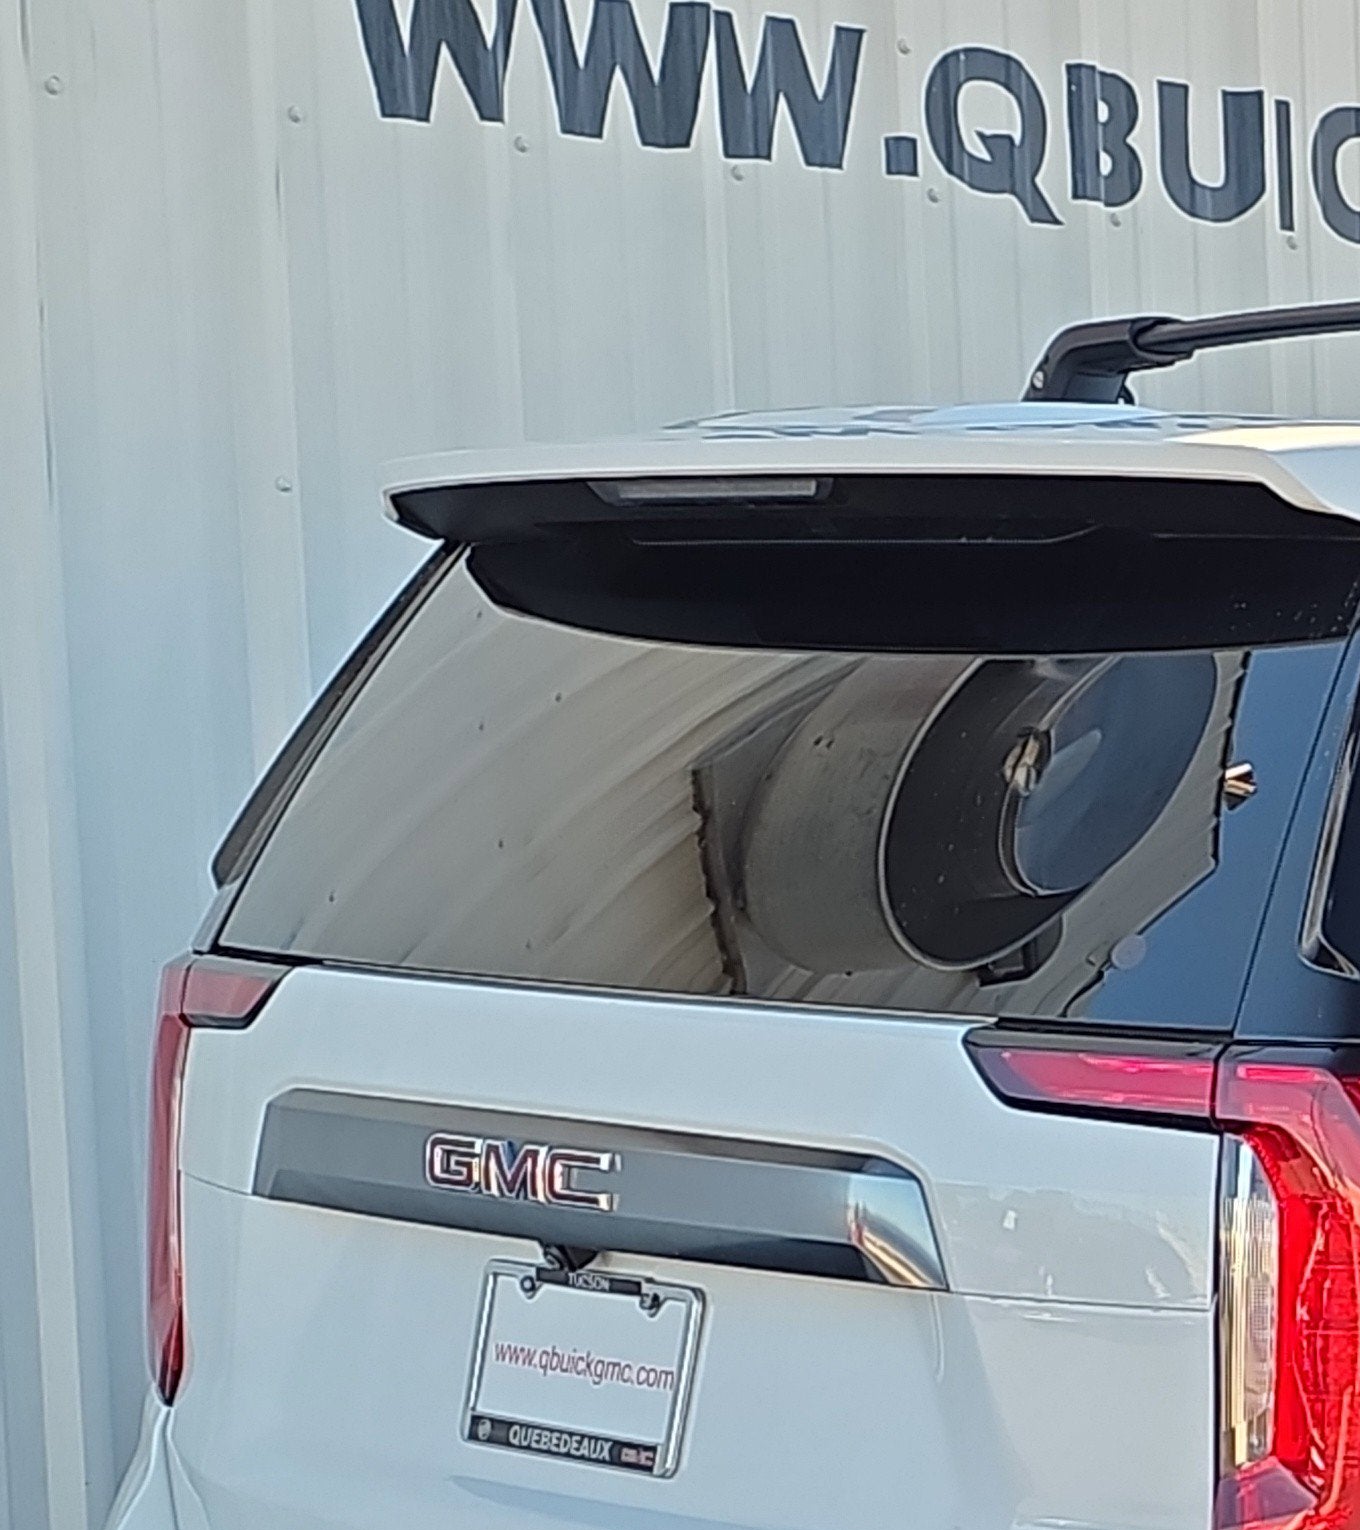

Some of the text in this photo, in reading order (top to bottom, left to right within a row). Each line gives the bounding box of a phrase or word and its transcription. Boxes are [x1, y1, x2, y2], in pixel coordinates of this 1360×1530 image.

[426, 1132, 622, 1212] GMC
[568, 1272, 610, 1291] TUCSON
[494, 1344, 675, 1391] www.qbuickgmc.com
[508, 1424, 613, 1461] QUEBEDEAUX
